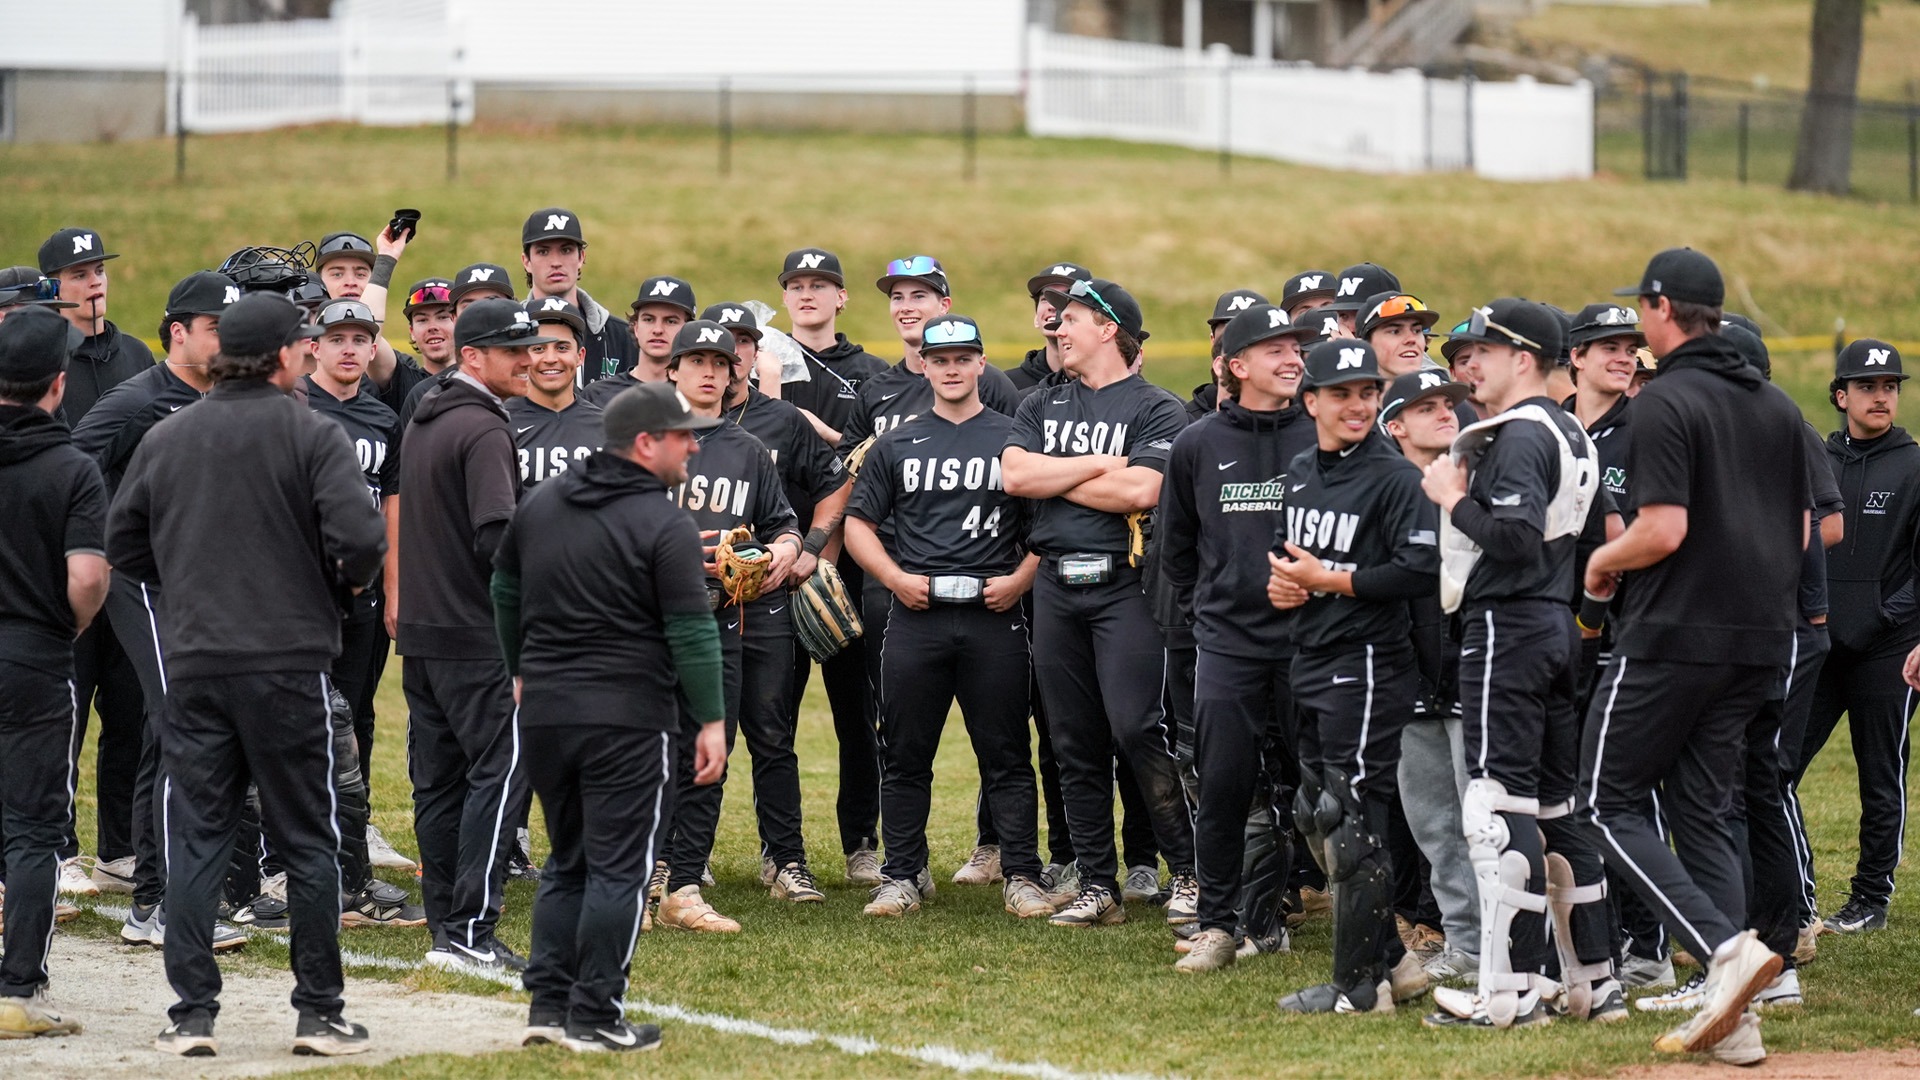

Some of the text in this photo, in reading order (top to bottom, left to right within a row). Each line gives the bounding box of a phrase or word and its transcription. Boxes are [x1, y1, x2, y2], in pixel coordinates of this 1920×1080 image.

[543, 214, 570, 231] N
[73, 234, 92, 254] N
[797, 254, 826, 269] N
[467, 268, 494, 283] N
[1051, 265, 1076, 277] N
[649, 280, 680, 297] N
[1299, 275, 1324, 293] N
[1337, 277, 1363, 297] N
[223, 285, 240, 304] N
[540, 298, 568, 312] N
[1227, 296, 1256, 312] N
[514, 311, 530, 323] N
[718, 308, 745, 324] N
[1268, 308, 1290, 328] N
[1320, 317, 1339, 335] N
[696, 327, 724, 344] N
[1336, 347, 1365, 370] N
[1864, 348, 1891, 366] N
[601, 357, 620, 376] N
[1418, 372, 1441, 390] N
[1042, 419, 1129, 457] BISON
[517, 446, 603, 482] BIS
[902, 456, 1003, 493] BISON
[1601, 466, 1627, 487] N
[666, 474, 751, 517] ISON
[1219, 482, 1285, 502] NICHOL
[1865, 491, 1891, 508] N
[961, 505, 1001, 539] 44
